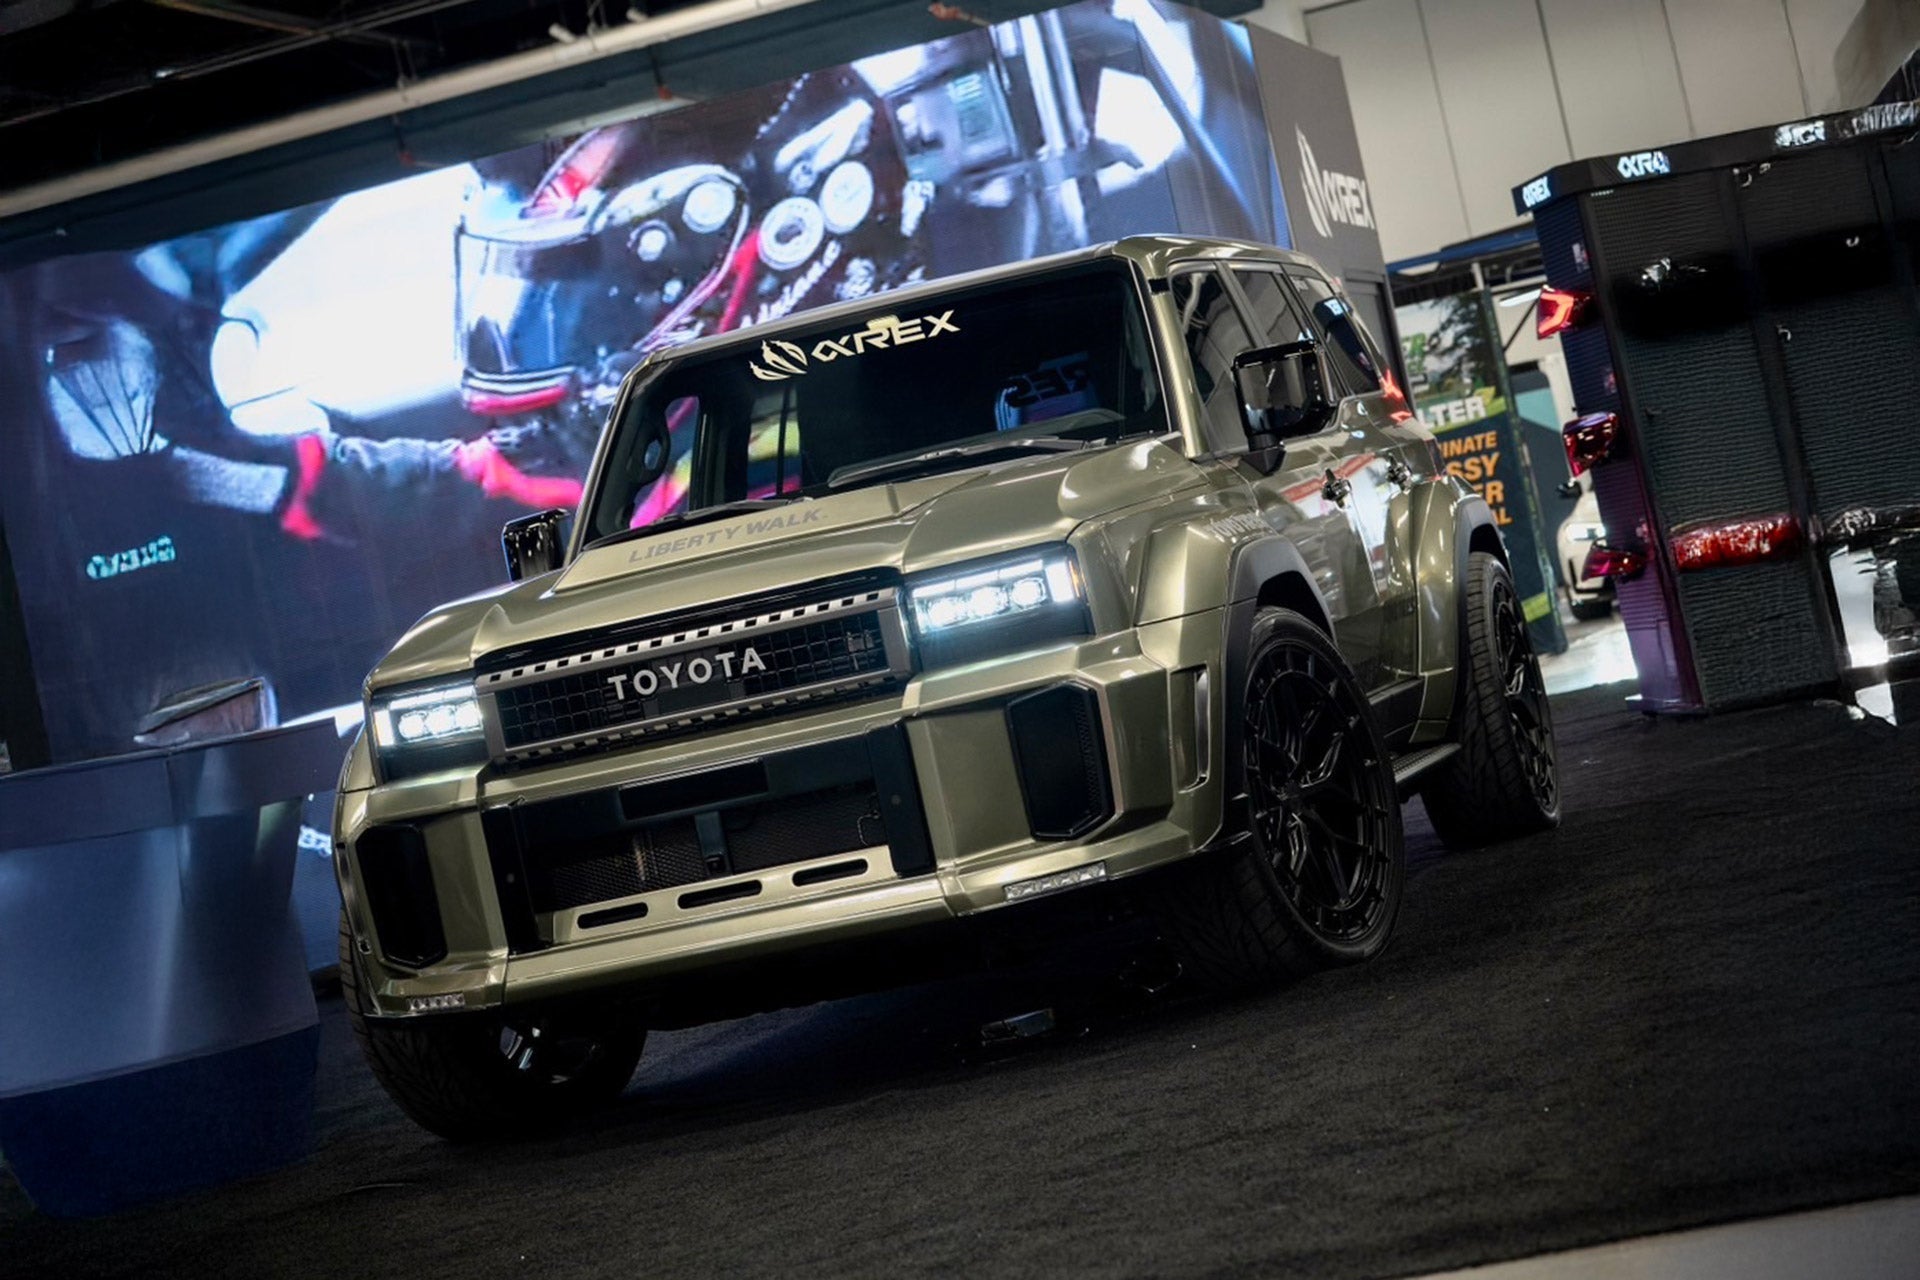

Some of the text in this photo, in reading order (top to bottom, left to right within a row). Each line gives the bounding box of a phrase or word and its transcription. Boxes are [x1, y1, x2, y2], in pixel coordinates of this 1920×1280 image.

[628, 508, 823, 563] LIBERTY WALK
[607, 647, 767, 700] TOYOTA
